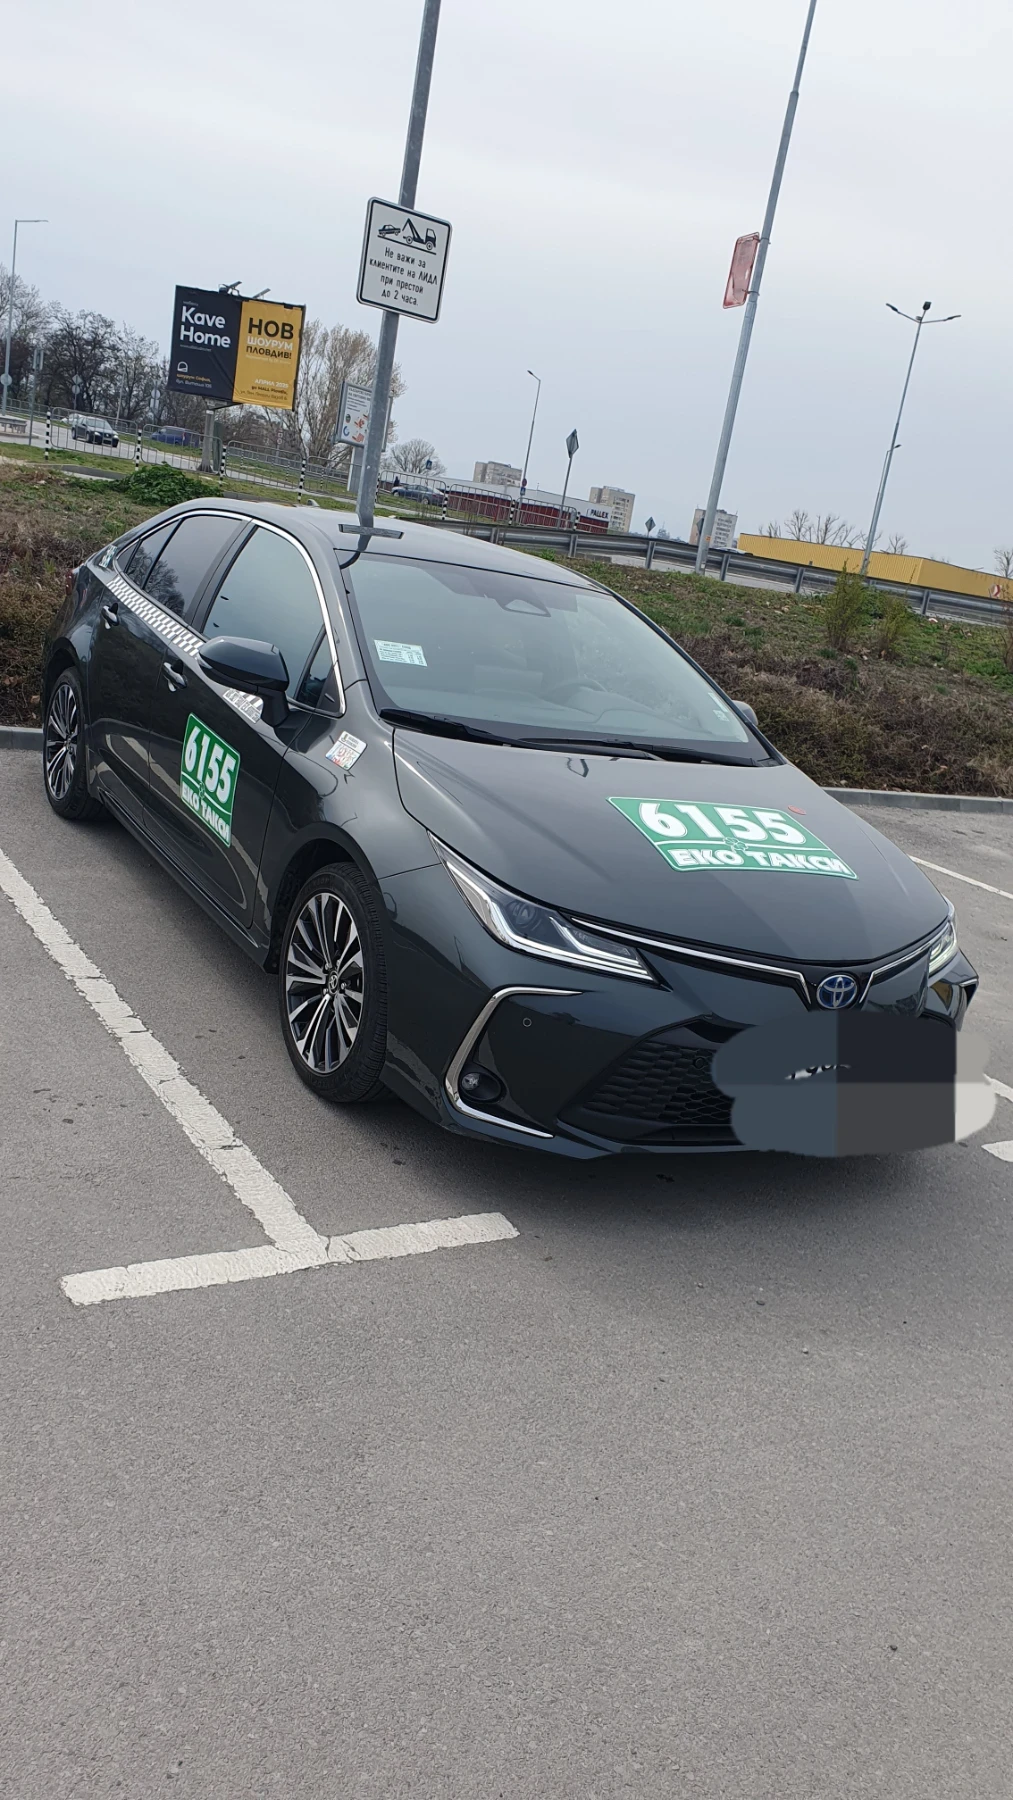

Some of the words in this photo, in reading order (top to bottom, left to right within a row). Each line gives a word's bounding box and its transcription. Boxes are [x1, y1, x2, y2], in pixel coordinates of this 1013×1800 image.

[384, 246, 394, 259] Не
[397, 253, 415, 265] важи
[417, 259, 426, 269] за
[369, 258, 405, 275] клиентите
[407, 269, 416, 279] на
[418, 270, 438, 285] ЛИДЛ
[380, 274, 394, 286] при
[381, 289, 391, 298] до
[394, 289, 399, 300] 2
[181, 305, 226, 329] Kave
[248, 317, 294, 340] НОВ
[180, 324, 231, 348] Home
[247, 335, 293, 351] ШОУРУМ
[246, 345, 292, 359] ПЛОВДИВ!
[590, 508, 609, 519] PALLEX
[184, 725, 237, 804] 6155
[181, 781, 200, 812] ЕКО
[200, 799, 231, 843] ТАКСИ
[638, 802, 807, 845] 6155
[667, 849, 745, 867] ЕКО
[742, 851, 851, 875] ТАКСИ
